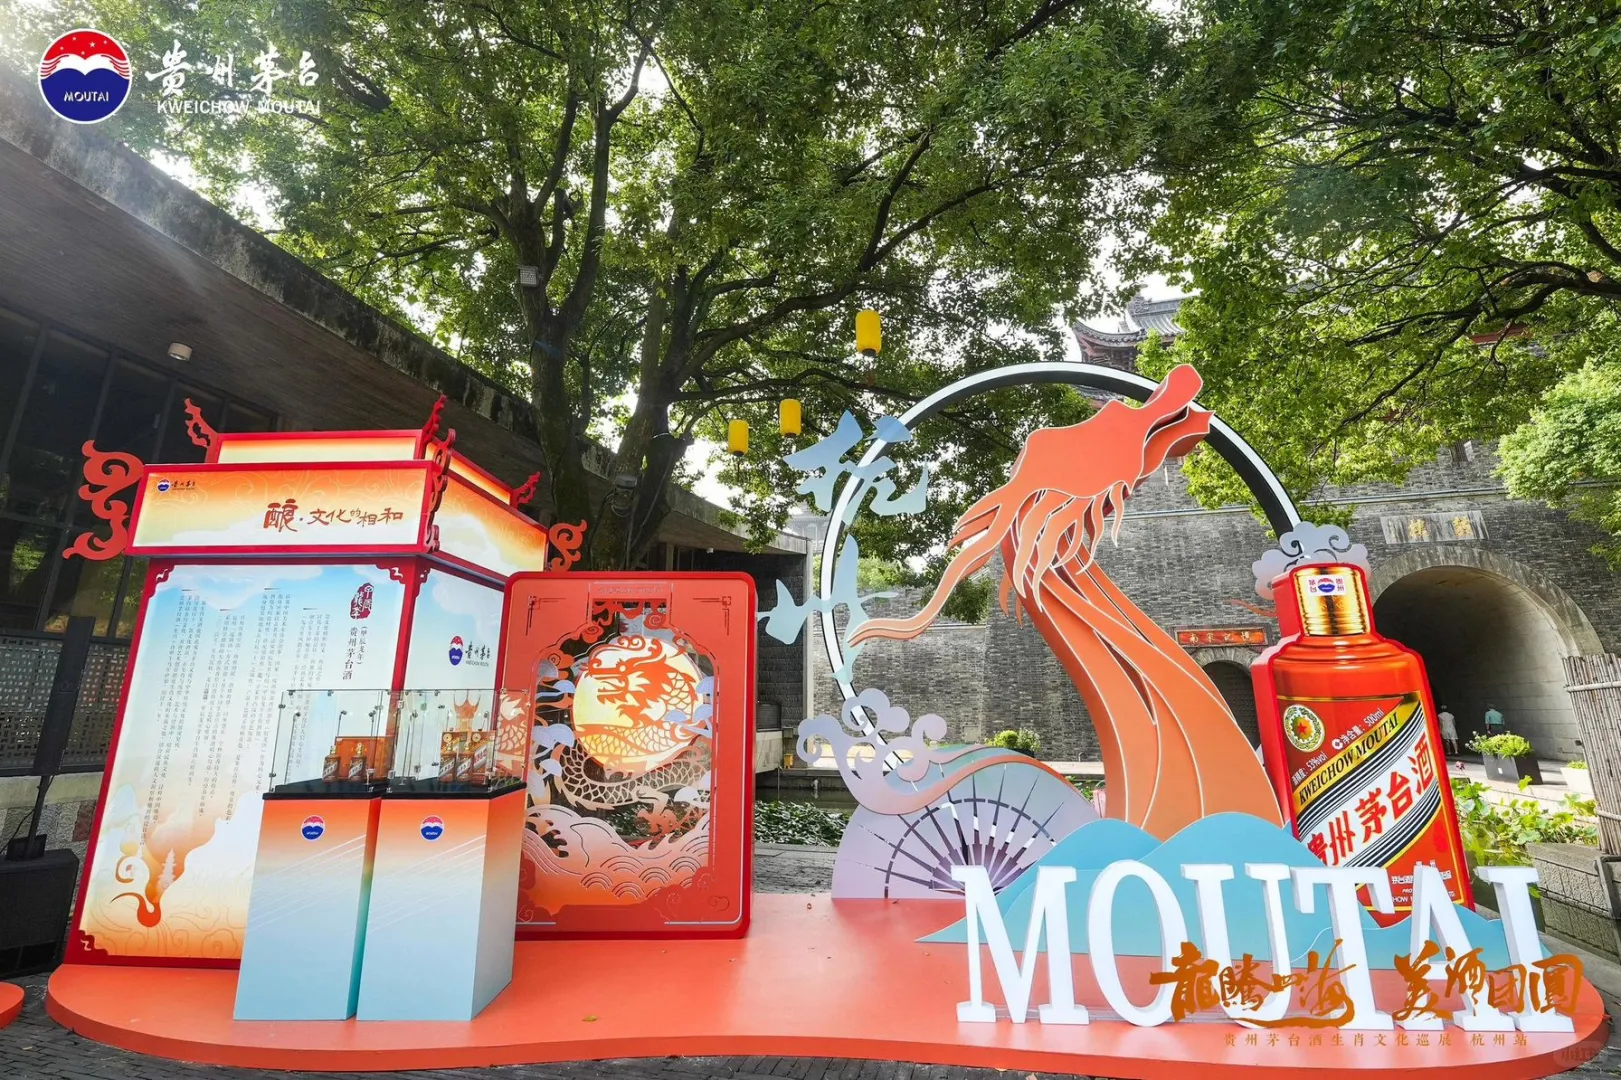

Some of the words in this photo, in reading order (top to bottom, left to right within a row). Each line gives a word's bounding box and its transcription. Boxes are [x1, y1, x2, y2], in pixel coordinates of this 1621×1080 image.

[1298, 749, 1354, 806] KWEICHOW
[1355, 712, 1399, 761] MOUTAI
[950, 860, 1575, 1033] MOUTAI
